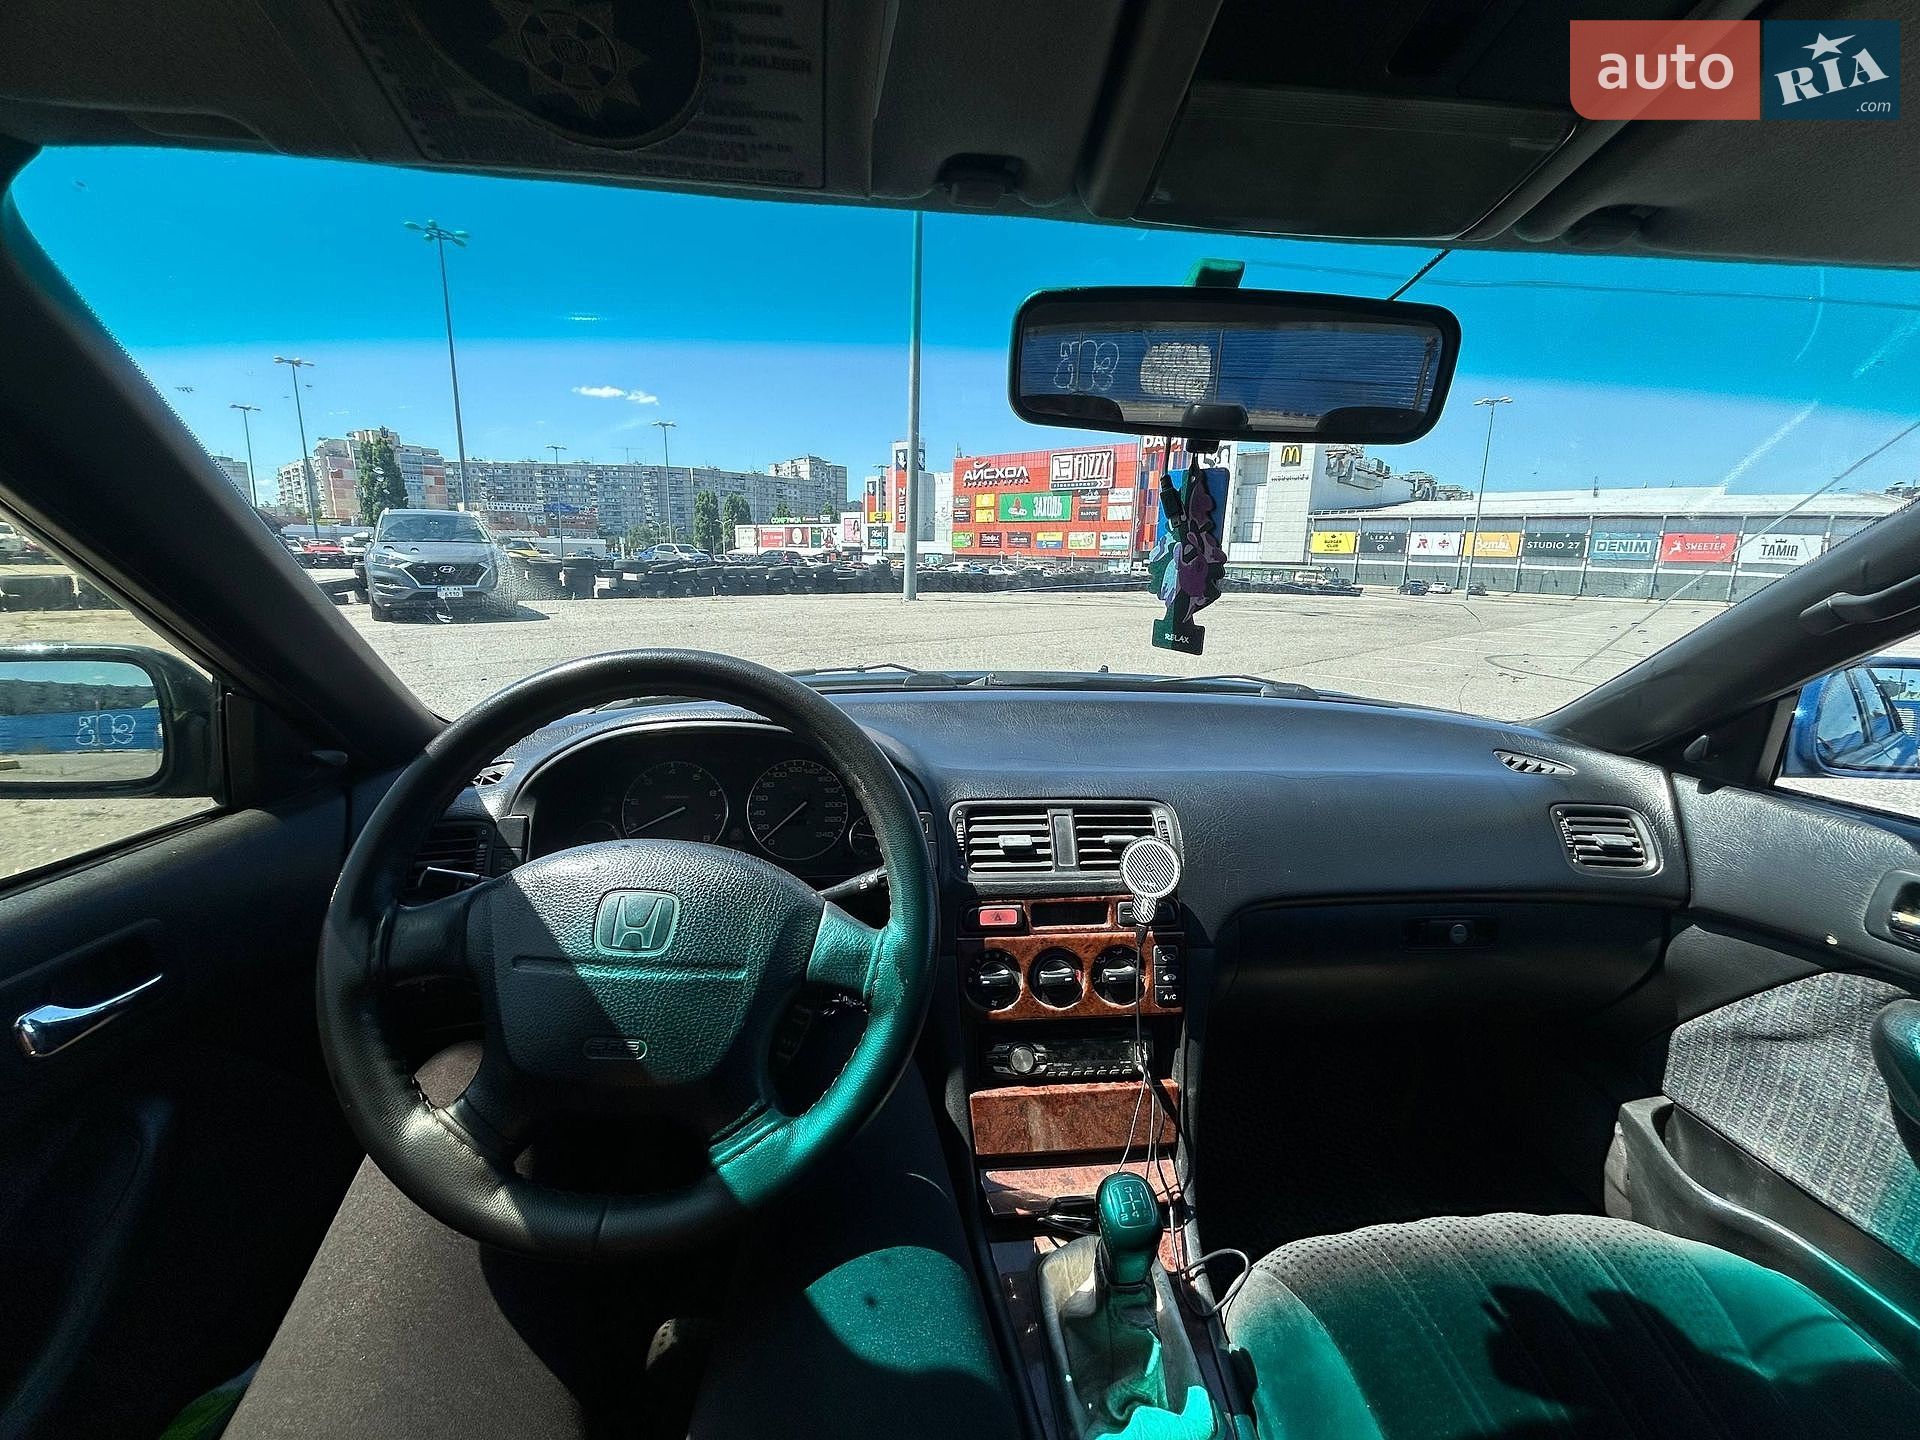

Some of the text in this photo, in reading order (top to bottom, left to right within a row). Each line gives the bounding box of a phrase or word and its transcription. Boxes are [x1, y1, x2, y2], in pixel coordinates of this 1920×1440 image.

[1074, 452, 1110, 480] FOZZY
[1527, 541, 1580, 549] STUDIO 27
[1597, 541, 1648, 552] DENIM
[1685, 542, 1726, 551] SWEETER
[1165, 633, 1189, 643] RELAX
